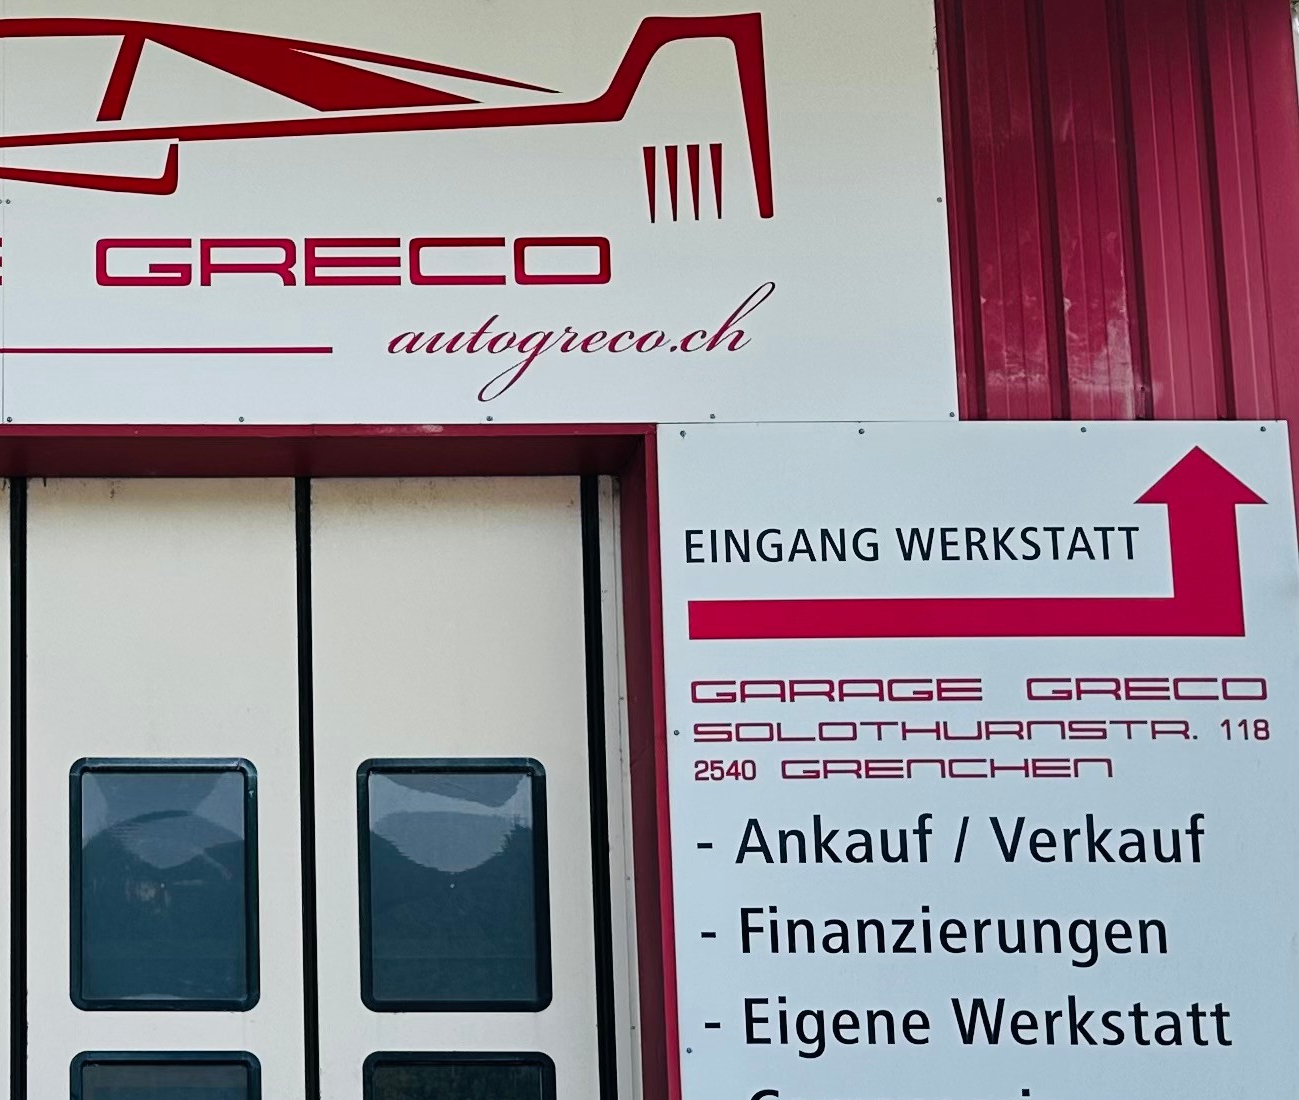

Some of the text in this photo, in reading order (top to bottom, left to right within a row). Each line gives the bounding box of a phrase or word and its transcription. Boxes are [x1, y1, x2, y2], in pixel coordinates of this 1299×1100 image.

[95, 236, 612, 287] GRECO
[387, 280, 777, 403] autogreco.ch
[685, 526, 1140, 564] EINGANG WERKSTATT
[690, 677, 1268, 704] GARAGE GRECO
[693, 718, 1270, 743] SOLOTHURNSTR. 118
[694, 758, 1114, 781] 2540 GRENCHEN
[735, 812, 933, 864] Ankauf
[988, 812, 1205, 864] Verkauf
[740, 905, 1168, 968] Finanzierungen
[744, 995, 931, 1059] Eigene
[950, 994, 1233, 1047] Werkstatt
